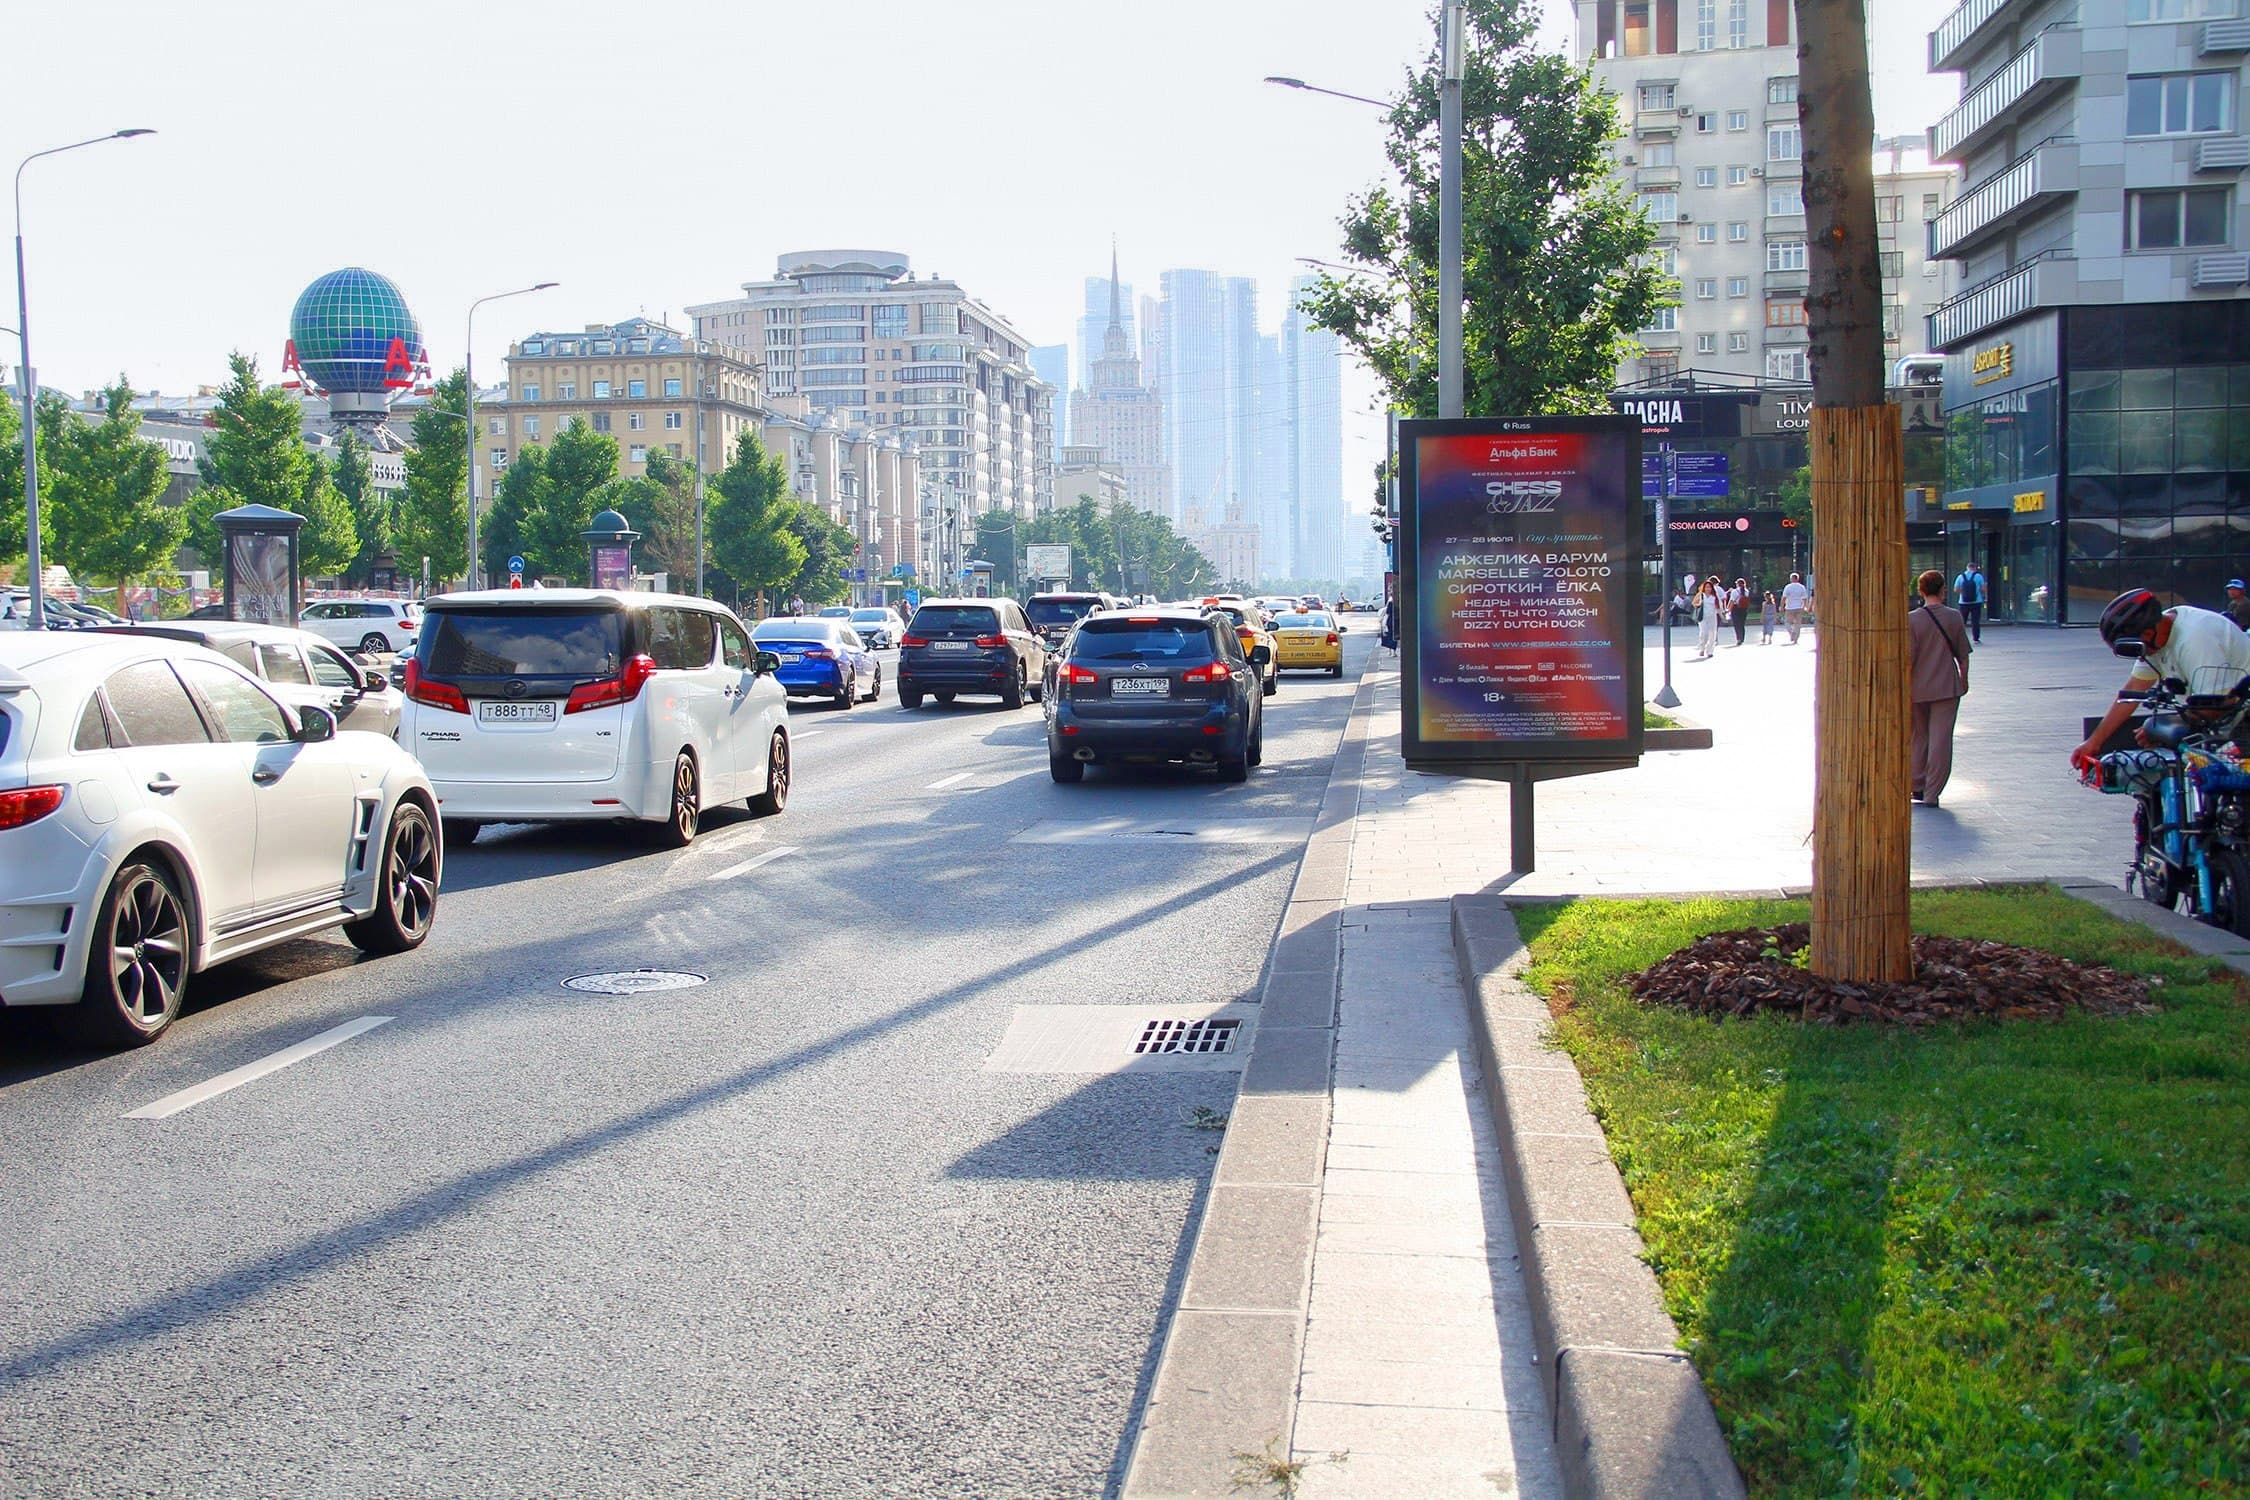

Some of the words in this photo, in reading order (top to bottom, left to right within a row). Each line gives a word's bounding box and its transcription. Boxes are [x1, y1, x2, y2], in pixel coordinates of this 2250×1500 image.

[1511, 422, 1531, 430] Russ
[1490, 447, 1527, 460] Альфа
[1529, 446, 1558, 457] Банк
[1486, 480, 1562, 495] CHESS
[1697, 521, 1731, 530] GARDEN
[1441, 554, 1542, 566] АНЖЕЛИКА
[1545, 553, 1608, 564] ВАРУМ
[1438, 568, 1530, 580] MARSELLE
[1542, 567, 1612, 578] ZOLOTO
[1448, 583, 1543, 594] СИРОТКИН
[1556, 580, 1602, 592] ЁЛКА
[1464, 599, 1511, 608] НЕДРЫ
[1520, 598, 1585, 606] МИНАЕВА
[1521, 609, 1548, 617] ЧТО
[1557, 608, 1598, 617] AMCHI
[1464, 621, 1500, 629] DIZZY
[1503, 621, 1548, 629] DUTCH
[1551, 620, 1585, 628] DUCK
[1576, 674, 1621, 683] Путешествия
[1482, 692, 1506, 703] 18+
